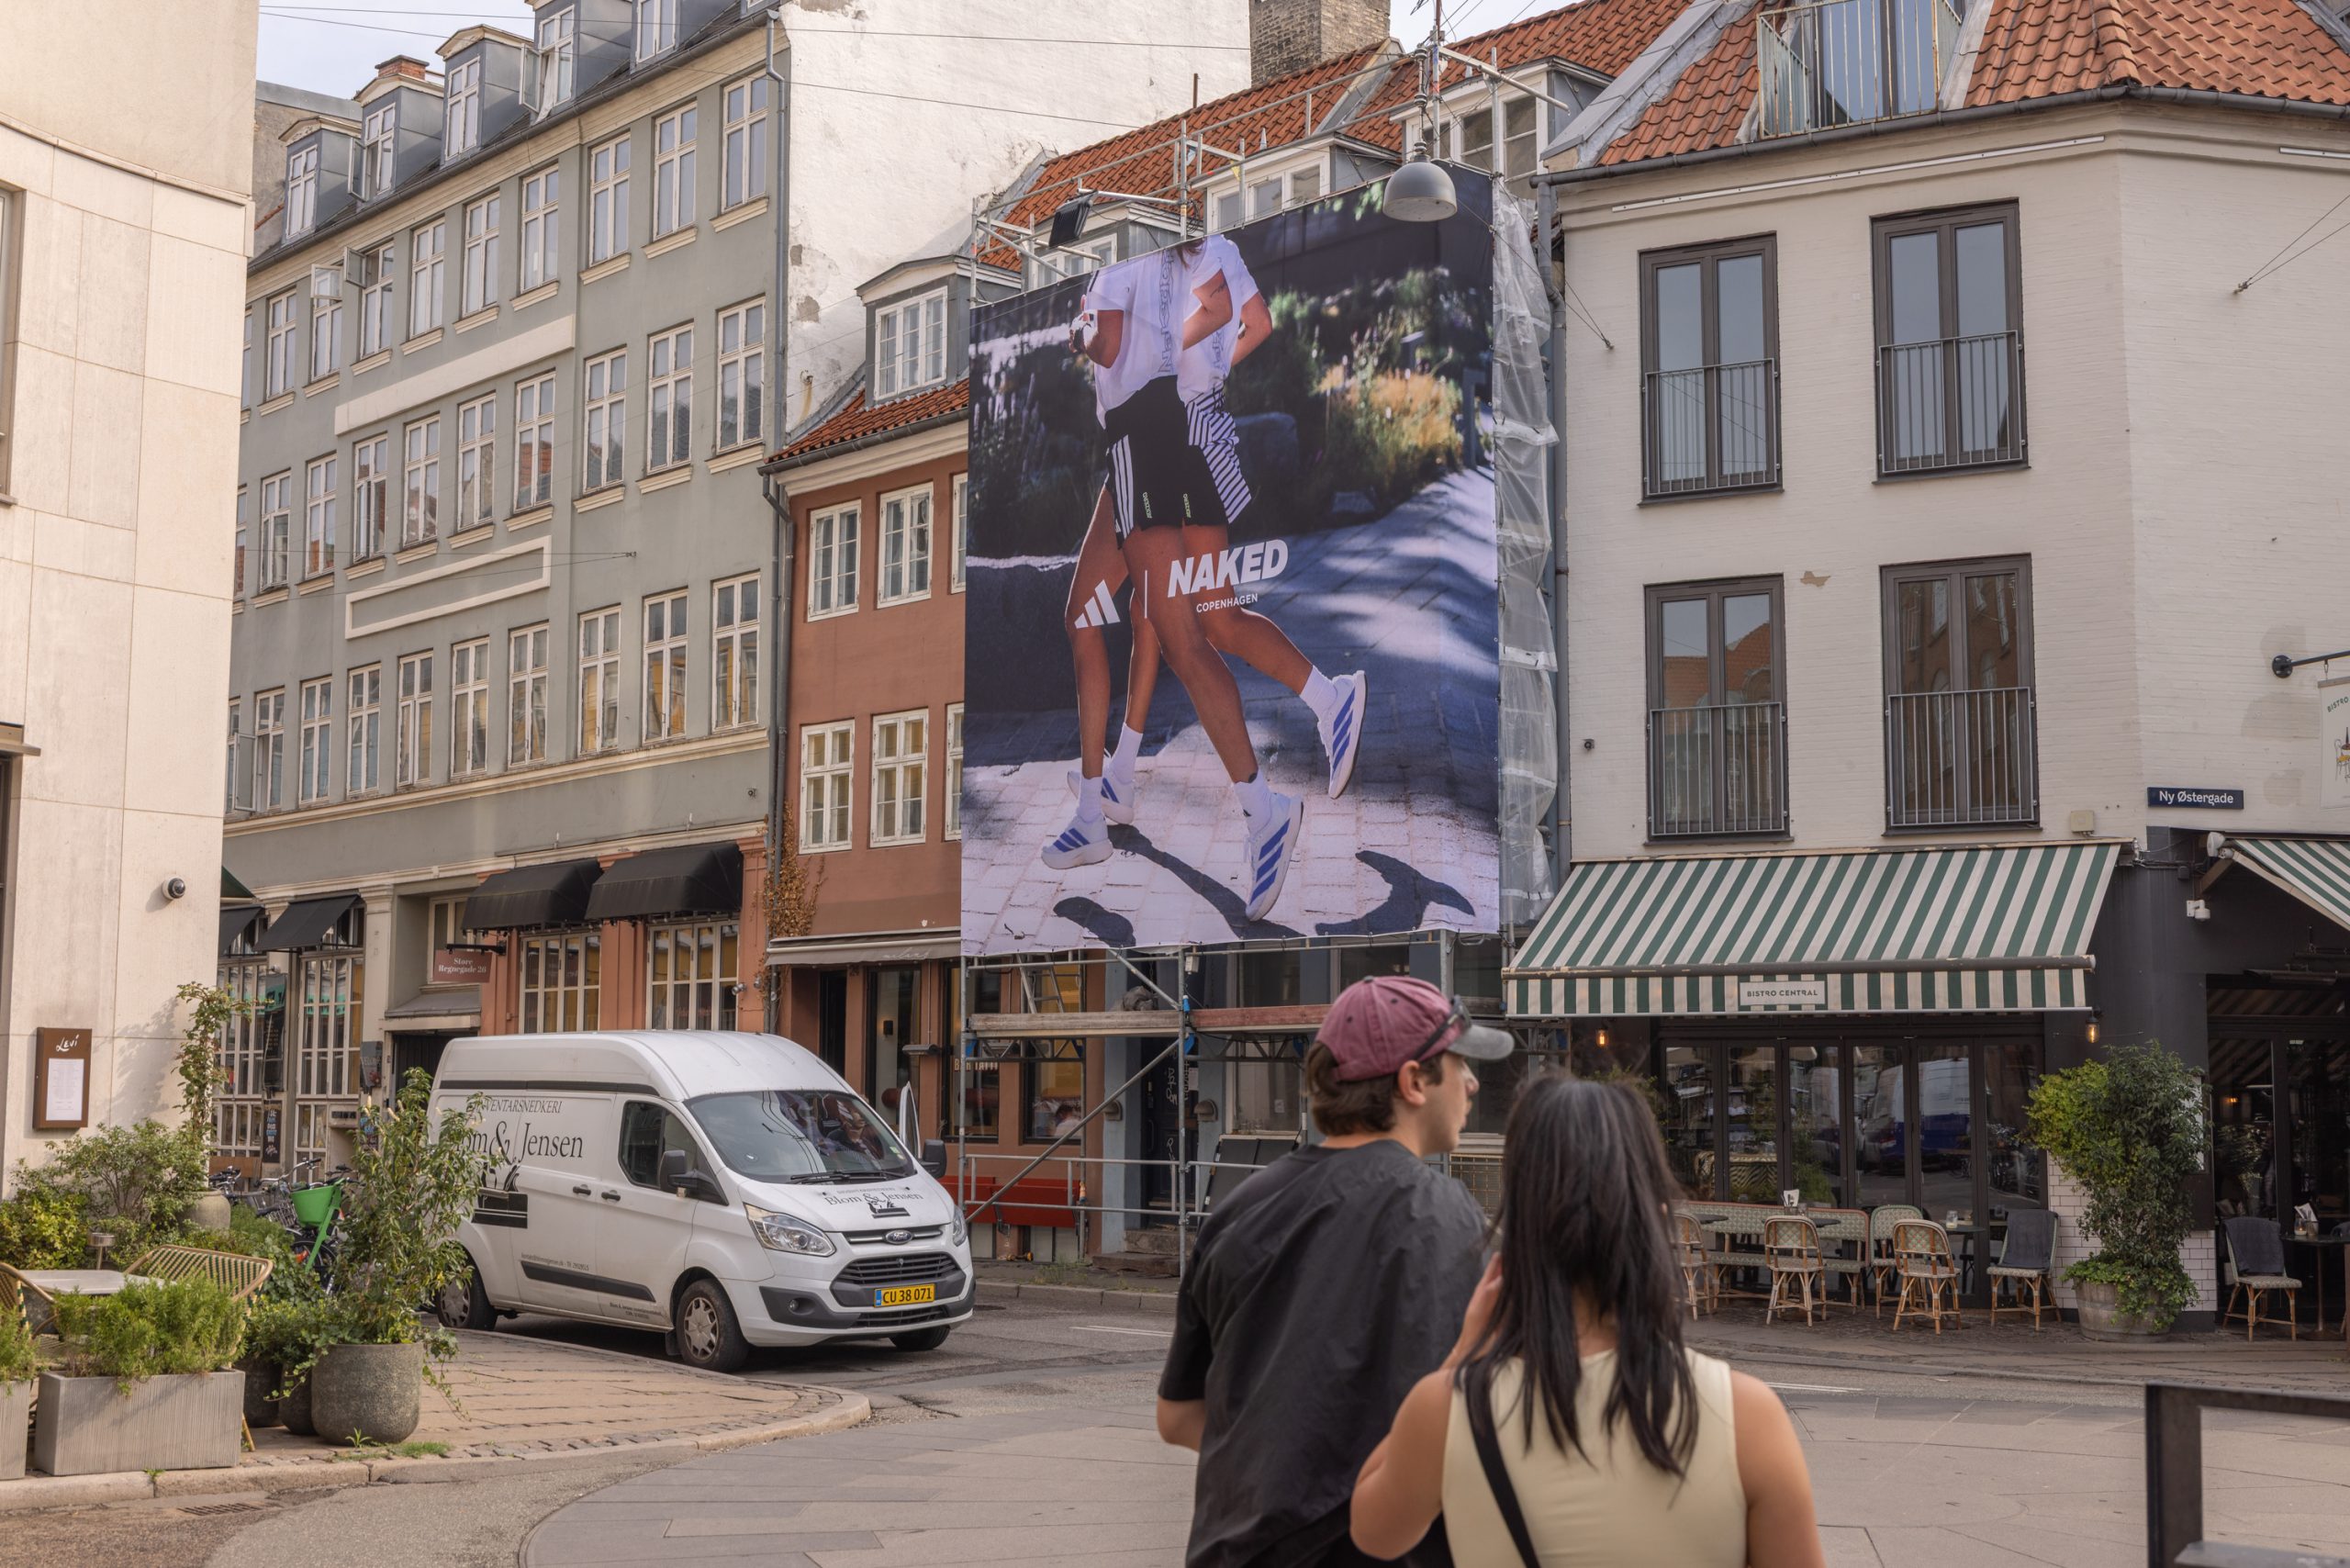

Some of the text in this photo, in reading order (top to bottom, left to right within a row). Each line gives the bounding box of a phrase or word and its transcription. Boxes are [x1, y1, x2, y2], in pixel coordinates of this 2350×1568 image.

[1167, 539, 1289, 599] NAKED
[1196, 593, 1259, 613] COPENHAGEN
[2327, 696, 2349, 713] BISTRO
[2159, 790, 2234, 806] Ny Østergade
[438, 964, 476, 974] Regnegade
[453, 957, 474, 965] Store
[489, 1121, 517, 1166] &
[519, 1122, 583, 1163] Jensen
[824, 1195, 862, 1205] Blom
[880, 1193, 924, 1203] Jensen
[882, 1291, 897, 1304] CU
[899, 1289, 912, 1302] 38
[913, 1288, 932, 1301] 071
